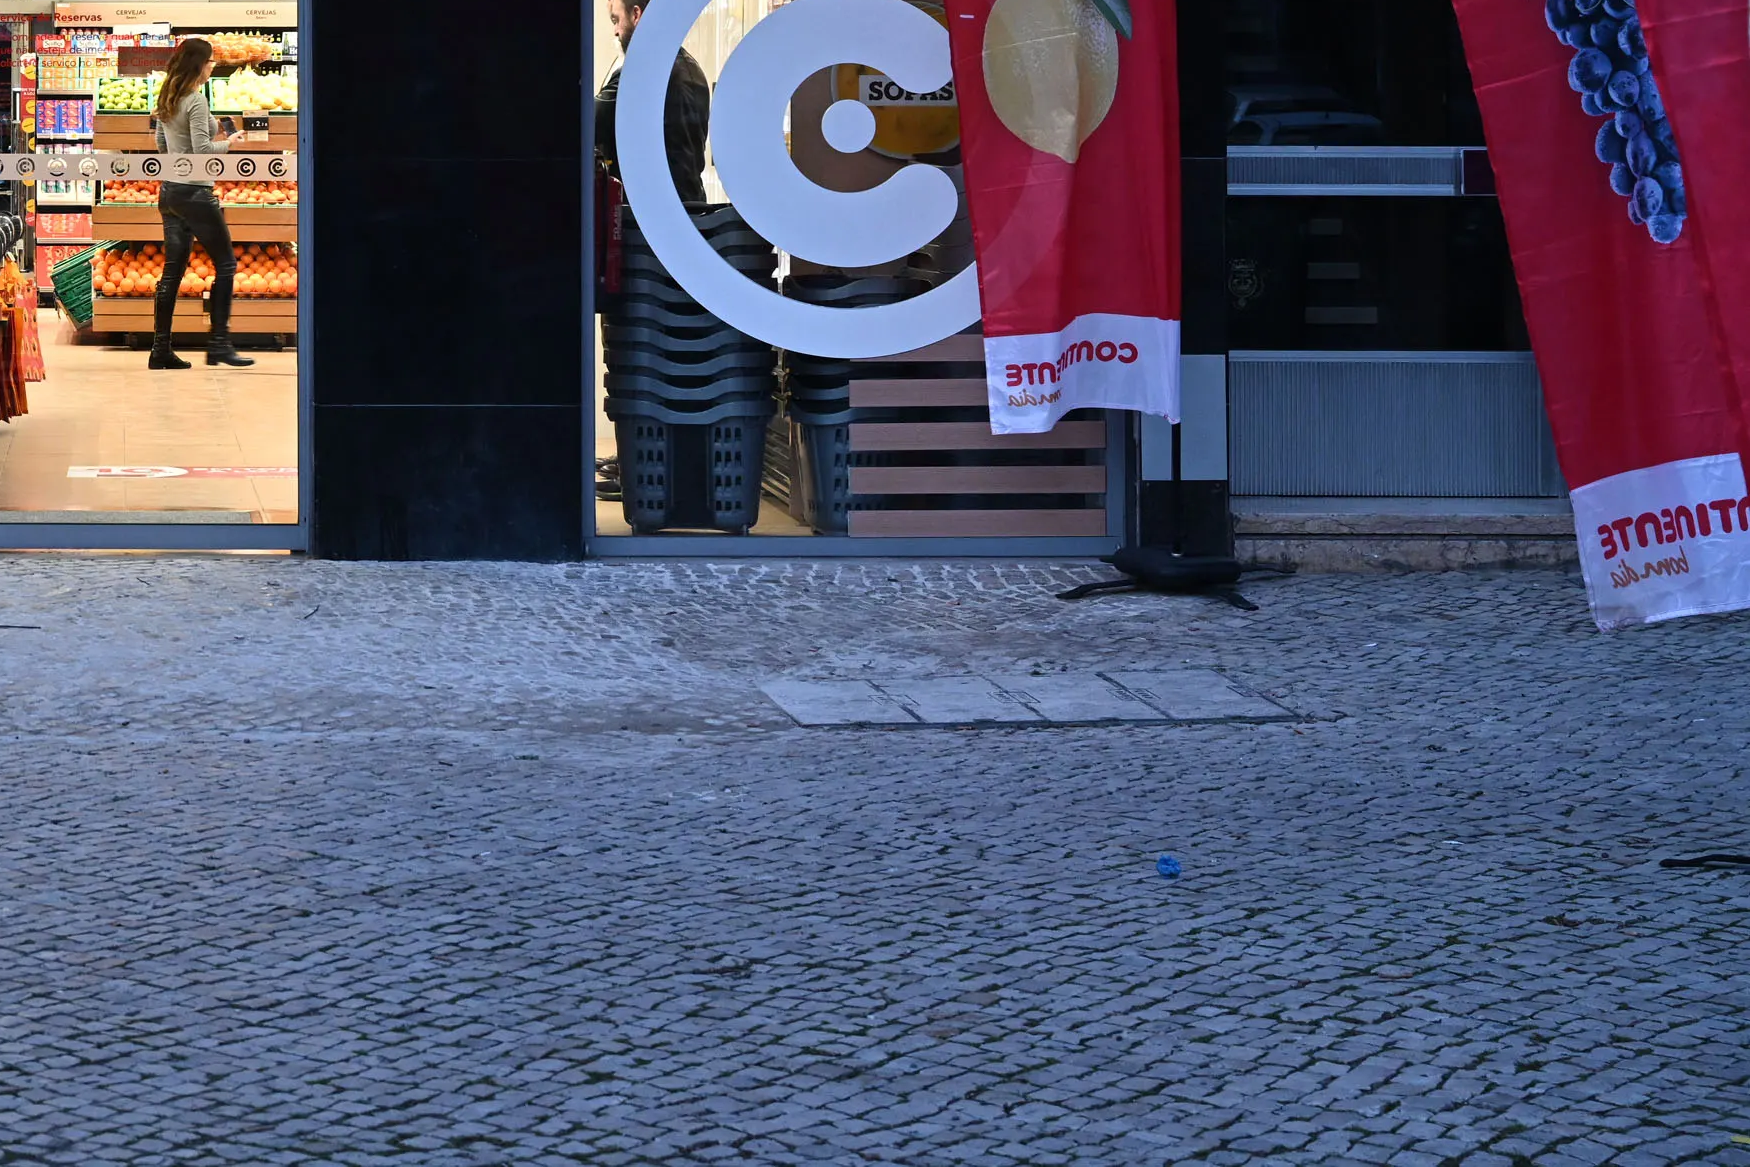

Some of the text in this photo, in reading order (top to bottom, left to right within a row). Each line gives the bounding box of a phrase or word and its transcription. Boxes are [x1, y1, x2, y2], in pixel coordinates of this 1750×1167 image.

[54, 12, 103, 22] Reservas
[69, 45, 83, 55] de
[41, 61, 76, 71] serviço
[79, 62, 93, 70] no
